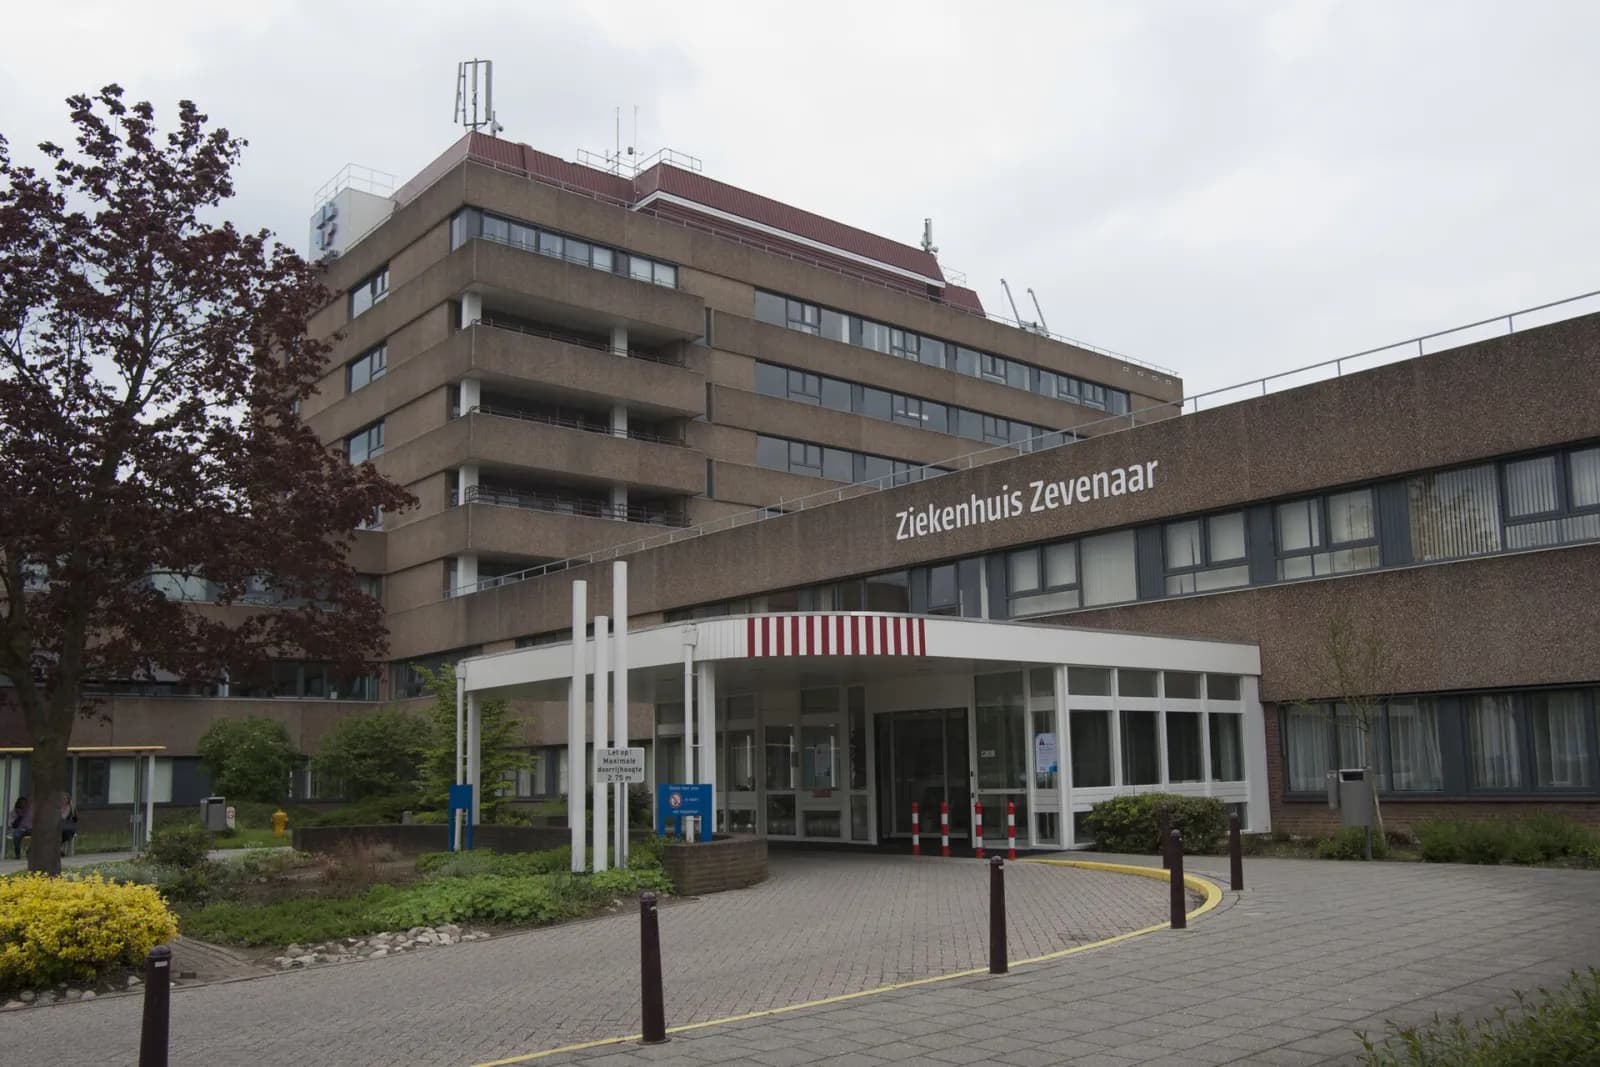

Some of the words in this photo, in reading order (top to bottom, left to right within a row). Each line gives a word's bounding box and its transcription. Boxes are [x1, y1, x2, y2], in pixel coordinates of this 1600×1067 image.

[895, 485, 1023, 540] Ziekenhuis
[1029, 459, 1159, 513] Zevenaar
[603, 757, 636, 765] Maximale
[597, 766, 642, 776] doorrijhoogte
